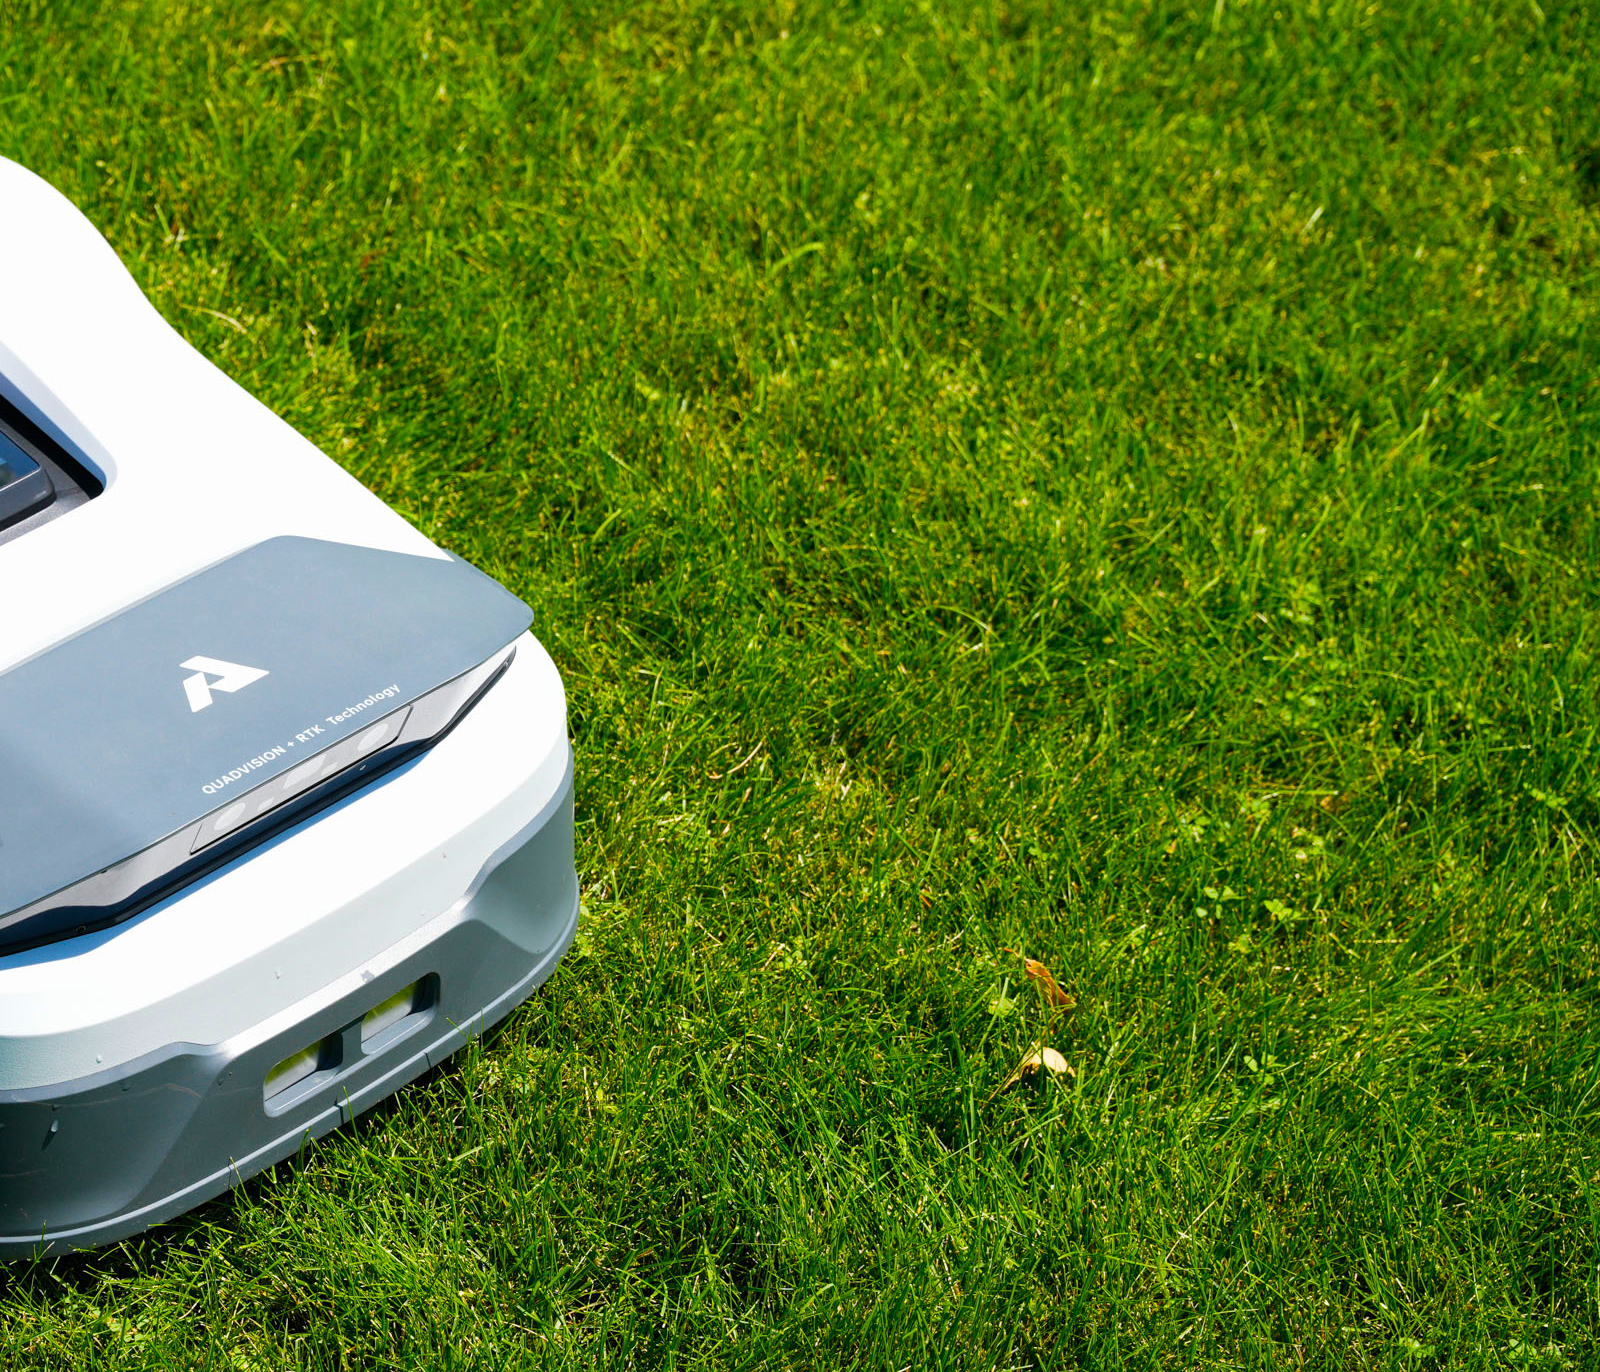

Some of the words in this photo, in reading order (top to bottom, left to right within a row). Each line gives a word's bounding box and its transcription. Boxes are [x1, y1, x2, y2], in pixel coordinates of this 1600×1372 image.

[201, 745, 287, 795] QUADVISION
[295, 724, 326, 743] RTK
[325, 683, 401, 725] Technology
